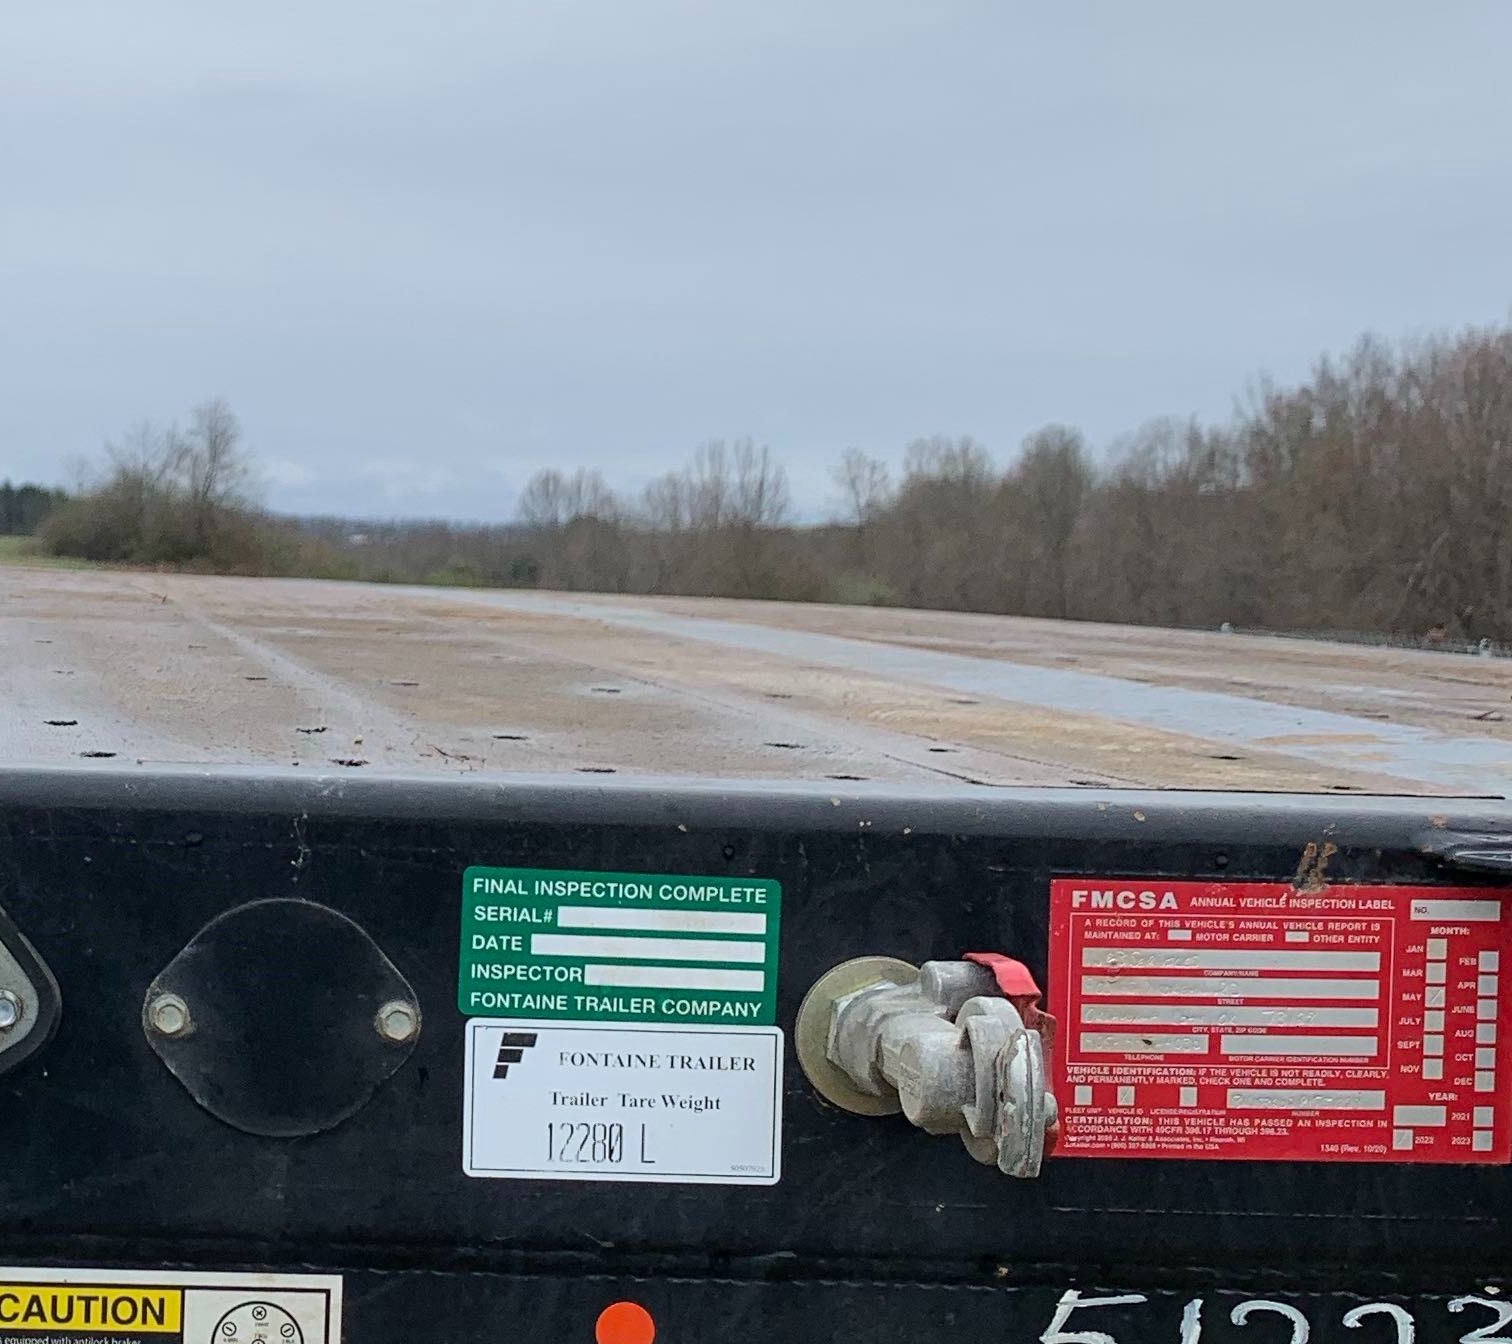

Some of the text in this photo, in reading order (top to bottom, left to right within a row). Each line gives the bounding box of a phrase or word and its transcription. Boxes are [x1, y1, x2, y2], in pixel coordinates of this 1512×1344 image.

[472, 876, 767, 904] FINAL INSPECTION COMPLETE
[1071, 889, 1179, 910] FMCSA
[1190, 896, 1394, 910] ANNUAL VEHICLE INSPECTION LABEL
[473, 905, 552, 923] SERIAL#
[1084, 918, 1379, 931] A RECORD OF THIS VEHICLE'S ANNUAL VEHICLE REPORT IS
[1084, 931, 1140, 940] MAINTAINED
[1430, 927, 1469, 935] MONTH:
[1195, 932, 1273, 942] MOTOR CARRIER
[1313, 934, 1379, 944] OTHER ENTITY
[472, 934, 522, 952] DATE
[1405, 945, 1423, 953] JAN
[471, 963, 582, 983] INSPECTOR
[470, 991, 761, 1017] FONTAINE TRAILER COMPANY
[1451, 1005, 1474, 1013] JUNE
[1398, 1017, 1420, 1025] JULY
[1454, 1029, 1474, 1037] AUG
[1397, 1041, 1419, 1049] SEPT
[559, 1051, 756, 1072] FONTAINE TRAILER
[1455, 1053, 1473, 1061] OCT
[1066, 1066, 1109, 1075] VEHICLE
[1198, 1068, 1207, 1076] IF
[1210, 1068, 1226, 1076] THE
[1230, 1068, 1268, 1077] VEHICLE
[1269, 1069, 1278, 1077] IS
[1280, 1069, 1299, 1077] NOT
[1454, 1077, 1472, 1085] DEC
[549, 1091, 721, 1113] Trailer Tare Weight
[1451, 1112, 1469, 1120] 2021
[546, 1120, 657, 1165] 12280 L
[1414, 1136, 1434, 1144] 2022
